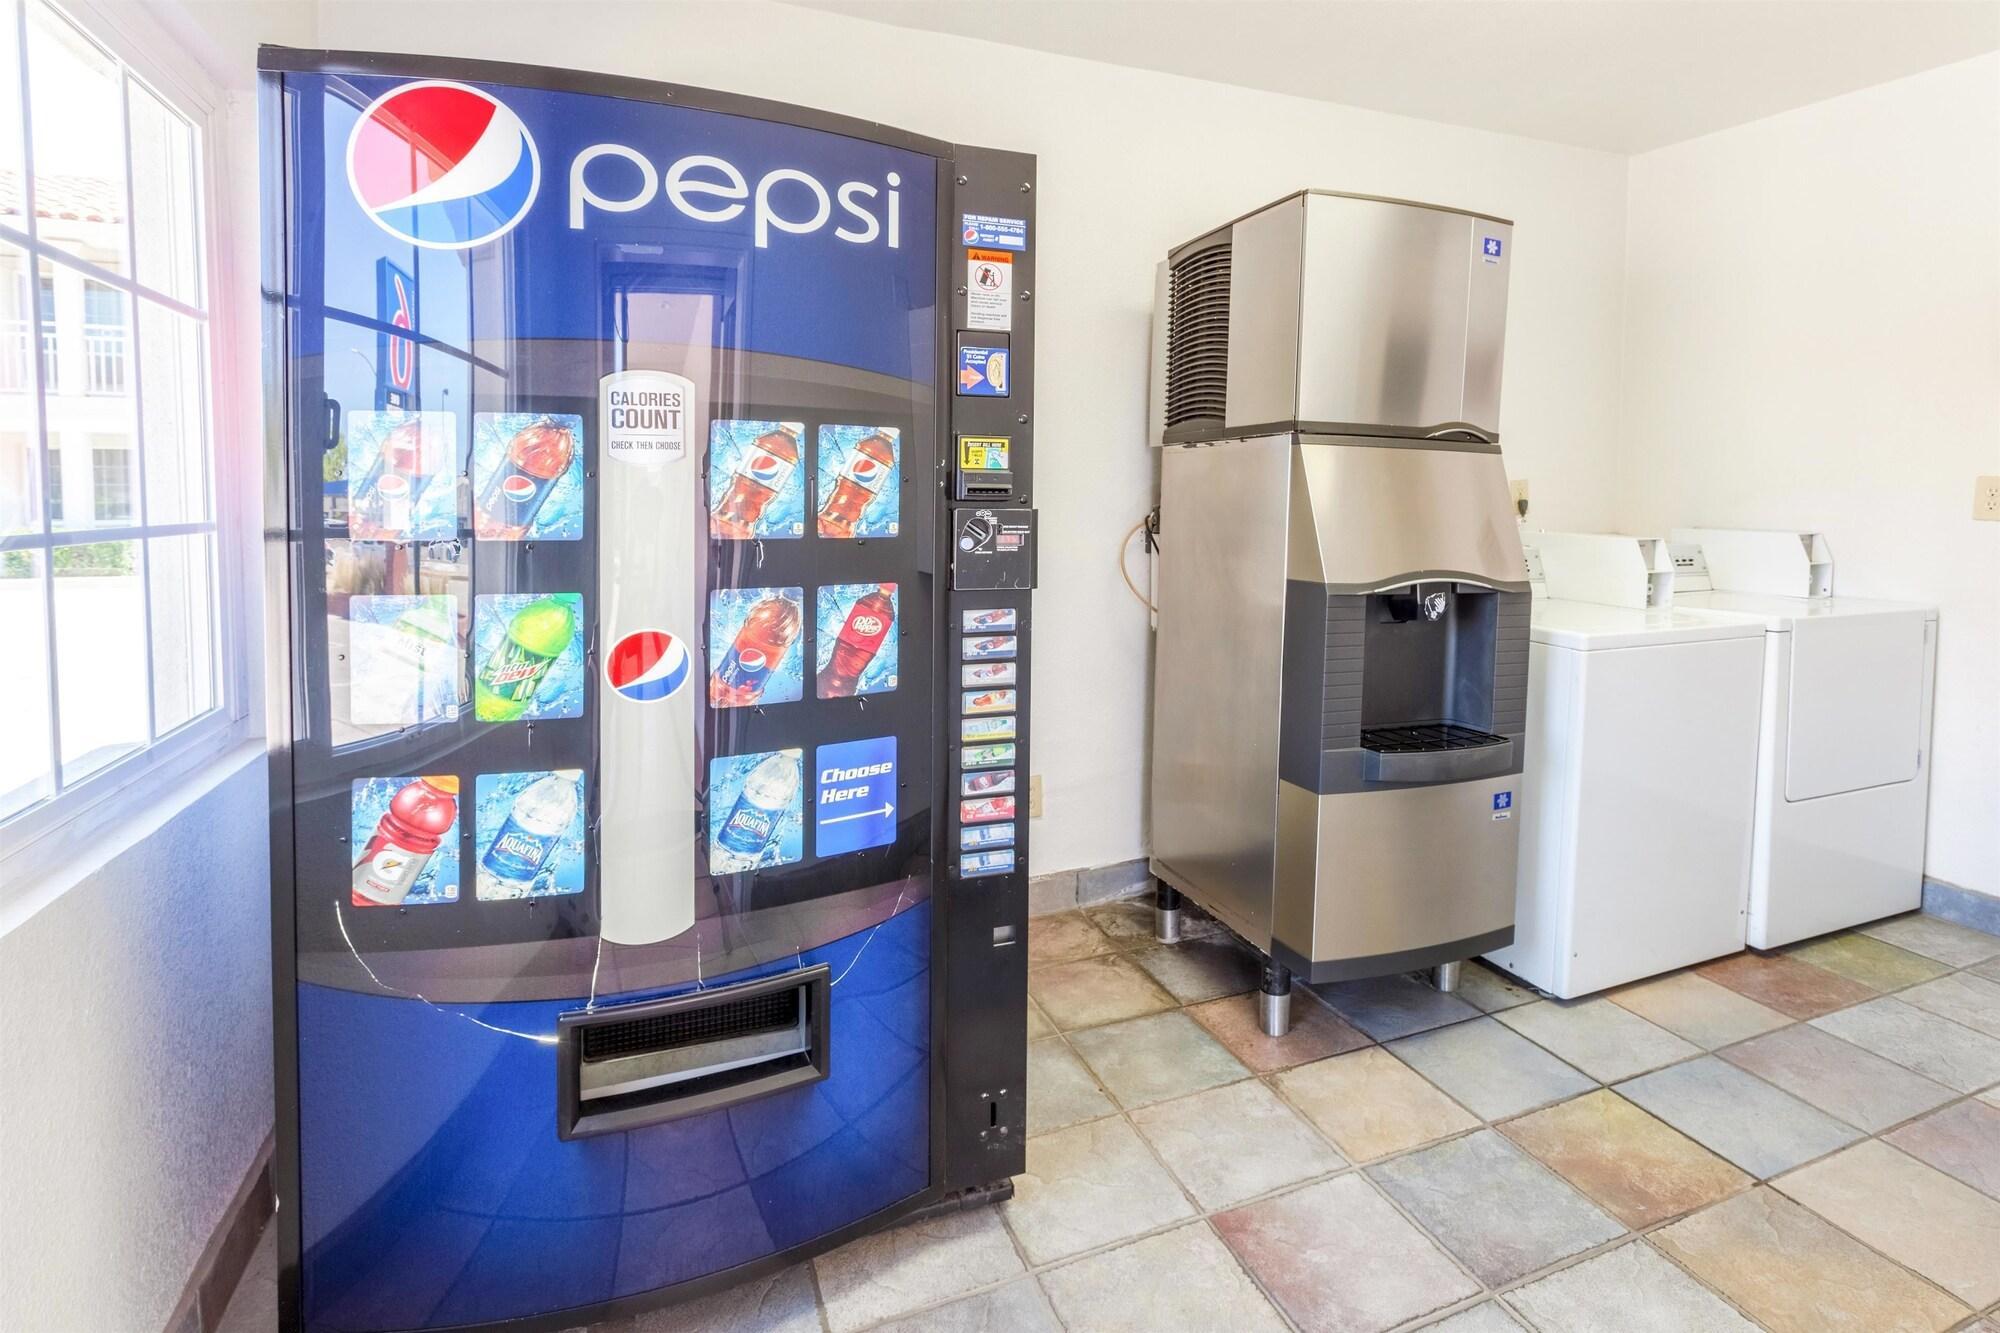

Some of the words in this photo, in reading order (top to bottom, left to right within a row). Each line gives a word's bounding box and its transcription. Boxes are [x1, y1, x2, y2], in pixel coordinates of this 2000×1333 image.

[570, 143, 901, 248] pepsi
[981, 254, 1009, 263] WARNING
[610, 391, 681, 407] CALORIES
[611, 408, 681, 430] COUNT
[611, 440, 634, 450] CHECK
[636, 440, 653, 450] THEN
[655, 441, 681, 450] CHOOSE
[820, 761, 893, 785] Choose
[820, 785, 870, 805] Here
